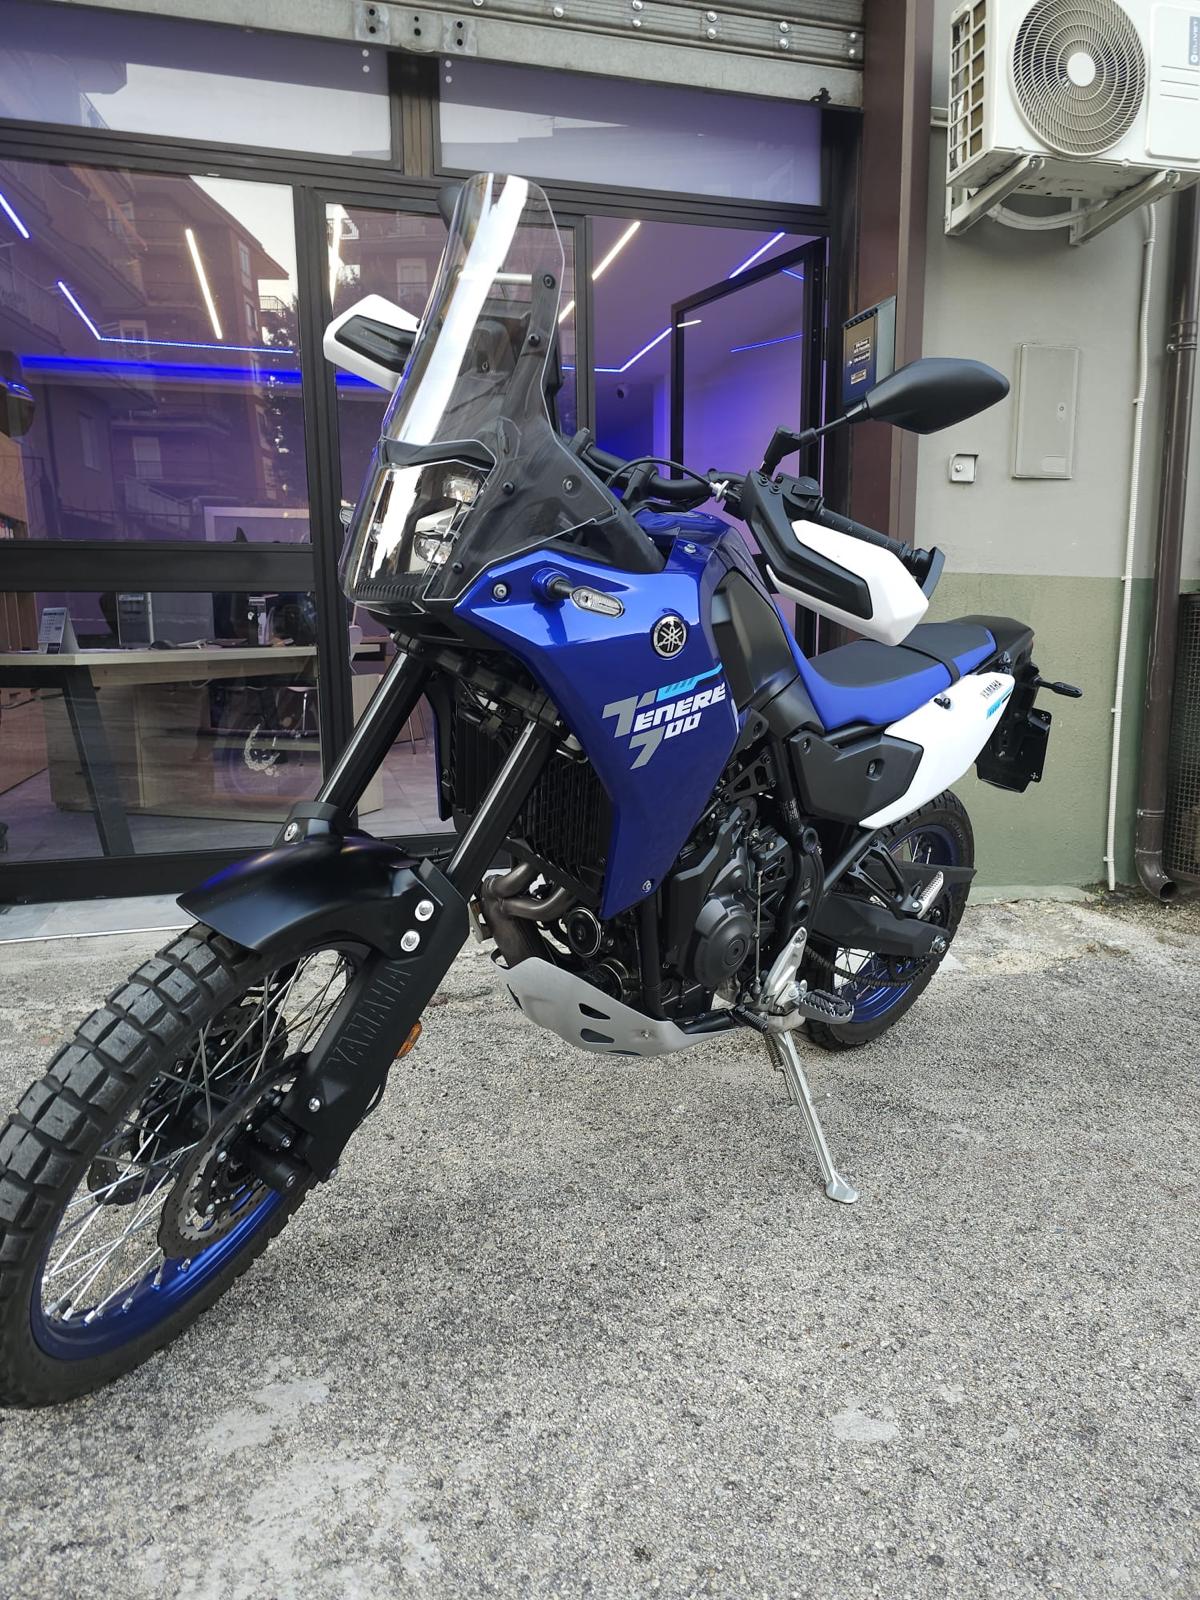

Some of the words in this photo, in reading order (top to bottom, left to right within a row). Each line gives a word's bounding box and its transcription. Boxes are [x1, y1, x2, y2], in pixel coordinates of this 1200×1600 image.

[980, 680, 1002, 699] YAMAHA
[629, 712, 702, 770] 700
[326, 966, 412, 1066] YAMAHA
